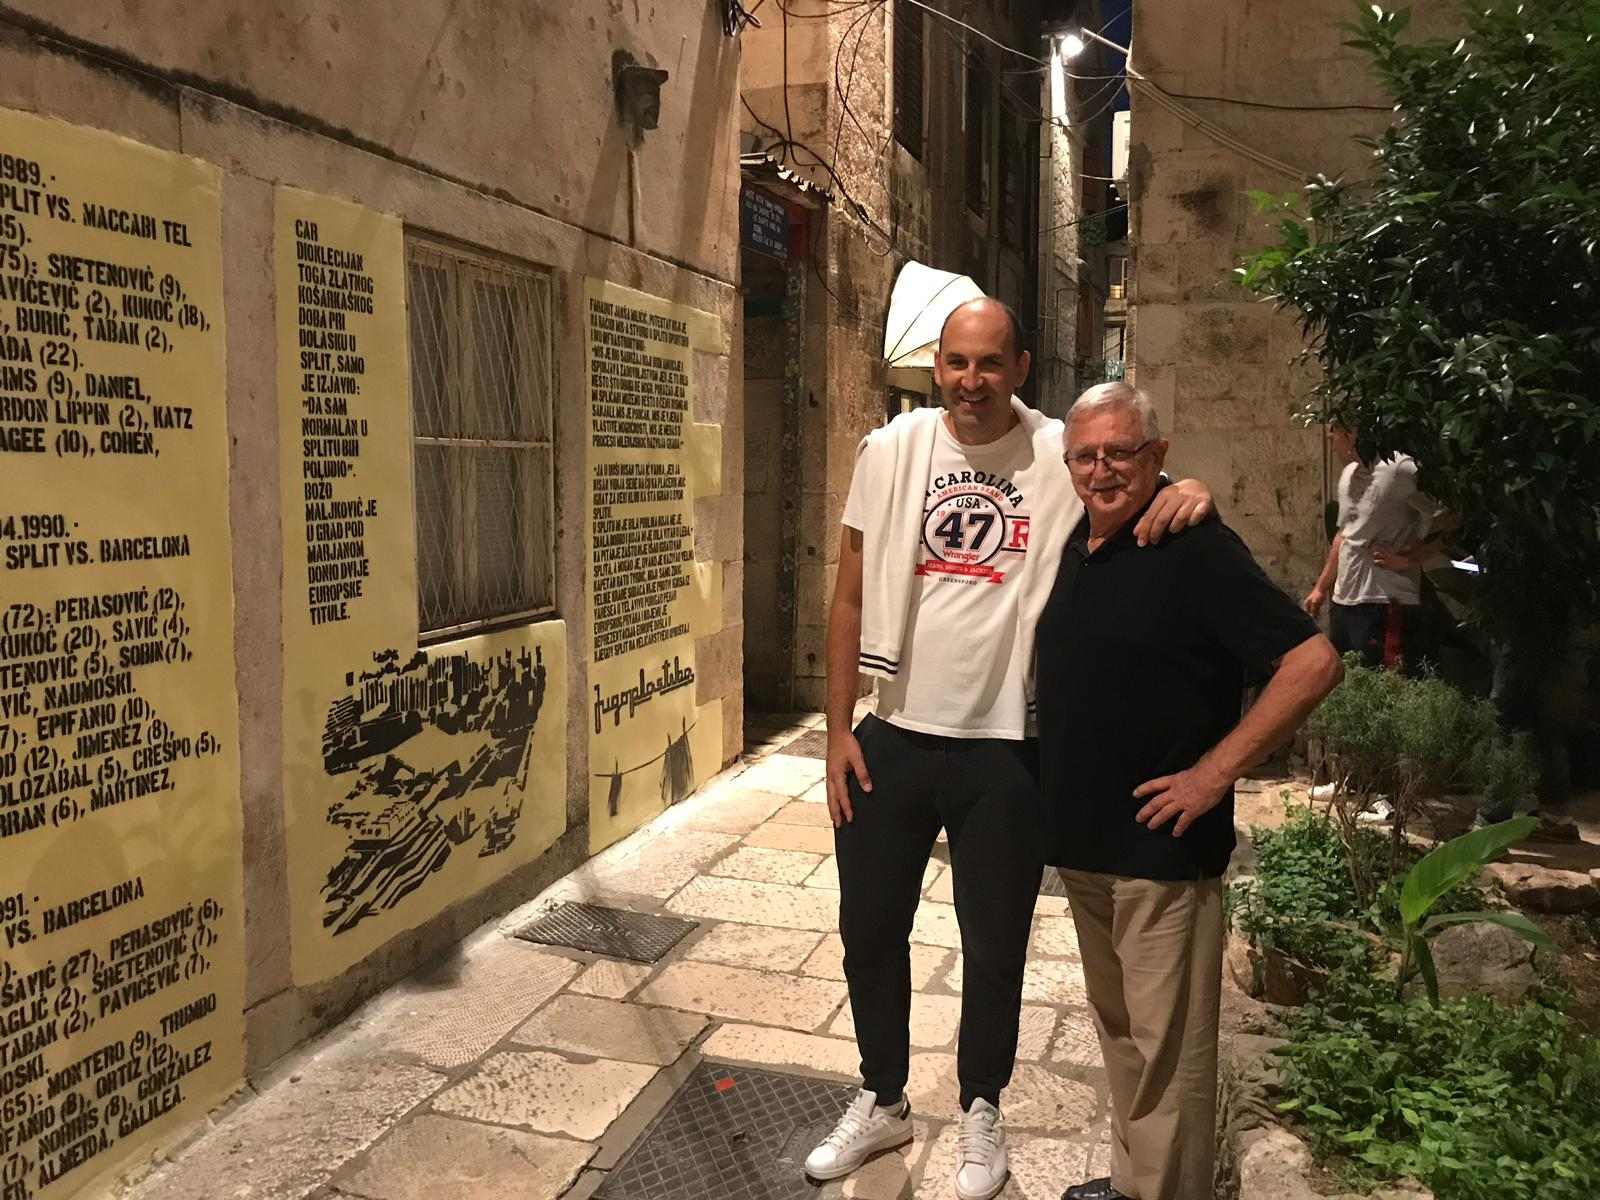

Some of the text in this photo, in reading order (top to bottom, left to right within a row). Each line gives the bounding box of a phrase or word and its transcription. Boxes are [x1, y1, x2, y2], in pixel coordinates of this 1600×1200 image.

[46, 193, 76, 223] VS.
[82, 203, 156, 240] MACCABI
[163, 220, 192, 247] TEL
[295, 219, 318, 241] CAR
[297, 241, 363, 272] DIOKLECIJAN
[159, 273, 187, 302] (9),
[298, 263, 374, 294] TOGA ZLATNOG
[86, 290, 117, 319] (2),
[178, 303, 210, 331] (18),
[299, 307, 345, 331] DOBA PRI
[83, 316, 140, 345] TABAK
[145, 326, 173, 353] (2),
[299, 328, 356, 352] DOLASKU U
[39, 342, 84, 372] (22).
[300, 351, 365, 375] SPLIT, SAMO
[47, 371, 80, 400] (9),
[85, 373, 151, 404] DANIEL,
[301, 373, 360, 395] JE IZJAVIO:
[55, 400, 110, 425] LIPPIN
[119, 405, 149, 432] (2),
[153, 406, 193, 430] KATZ
[324, 397, 347, 416] SAM
[302, 417, 368, 437] NORMALAN U
[55, 429, 96, 458] (10),
[101, 431, 160, 457] COHEN,
[303, 438, 359, 457] SPLITU BIH
[365, 500, 377, 517] JE
[956, 497, 980, 509] USA
[306, 520, 364, 542] U GRAD POD
[934, 512, 995, 550] 47
[6, 534, 191, 570] SPLIT VS. BARCELONA
[307, 540, 364, 564] MARJANOM
[943, 549, 980, 562] Wrangler
[308, 559, 369, 584] DONIO DVIJE
[309, 580, 362, 605] EUROPSKE
[2, 604, 51, 634] (72):
[153, 588, 185, 615] (12),
[310, 602, 351, 626] TITULE.
[64, 625, 107, 653] (20),
[162, 613, 190, 639] (4),
[83, 652, 114, 679] (5),
[44, 671, 136, 711] NAUMOSKI.
[37, 703, 116, 741] EPIFANIO
[122, 697, 156, 725] (10),
[24, 746, 65, 776] (12),
[72, 723, 142, 761] JIMENEZ
[147, 719, 175, 746] (8),
[98, 756, 128, 786] (5),
[132, 737, 191, 772] CRESPO
[195, 731, 222, 759] (5),
[52, 796, 86, 827] (6),
[90, 767, 176, 812] MARTINEZ,
[5, 876, 145, 948] VS. BARCELONA
[61, 949, 104, 985] (27),
[198, 897, 224, 925] (6),
[54, 985, 87, 1016] (2),
[192, 924, 218, 951] (7),
[0, 1019, 57, 1067] TABAK
[63, 1009, 95, 1039] (2),
[184, 951, 210, 980] (7),
[0, 1053, 49, 1095] OSKI.
[48, 1040, 125, 1099] MONTERO
[130, 1030, 157, 1060] (9),
[61, 1092, 91, 1121] (8),
[96, 1056, 142, 1099] ORTIZ
[147, 1043, 180, 1073] (12),
[3, 1040, 212, 1186] (7), NORRIS (8), GONZALEZ
[39, 1127, 114, 1189] ALMEIDA,
[119, 1084, 186, 1139] GALILEA.
